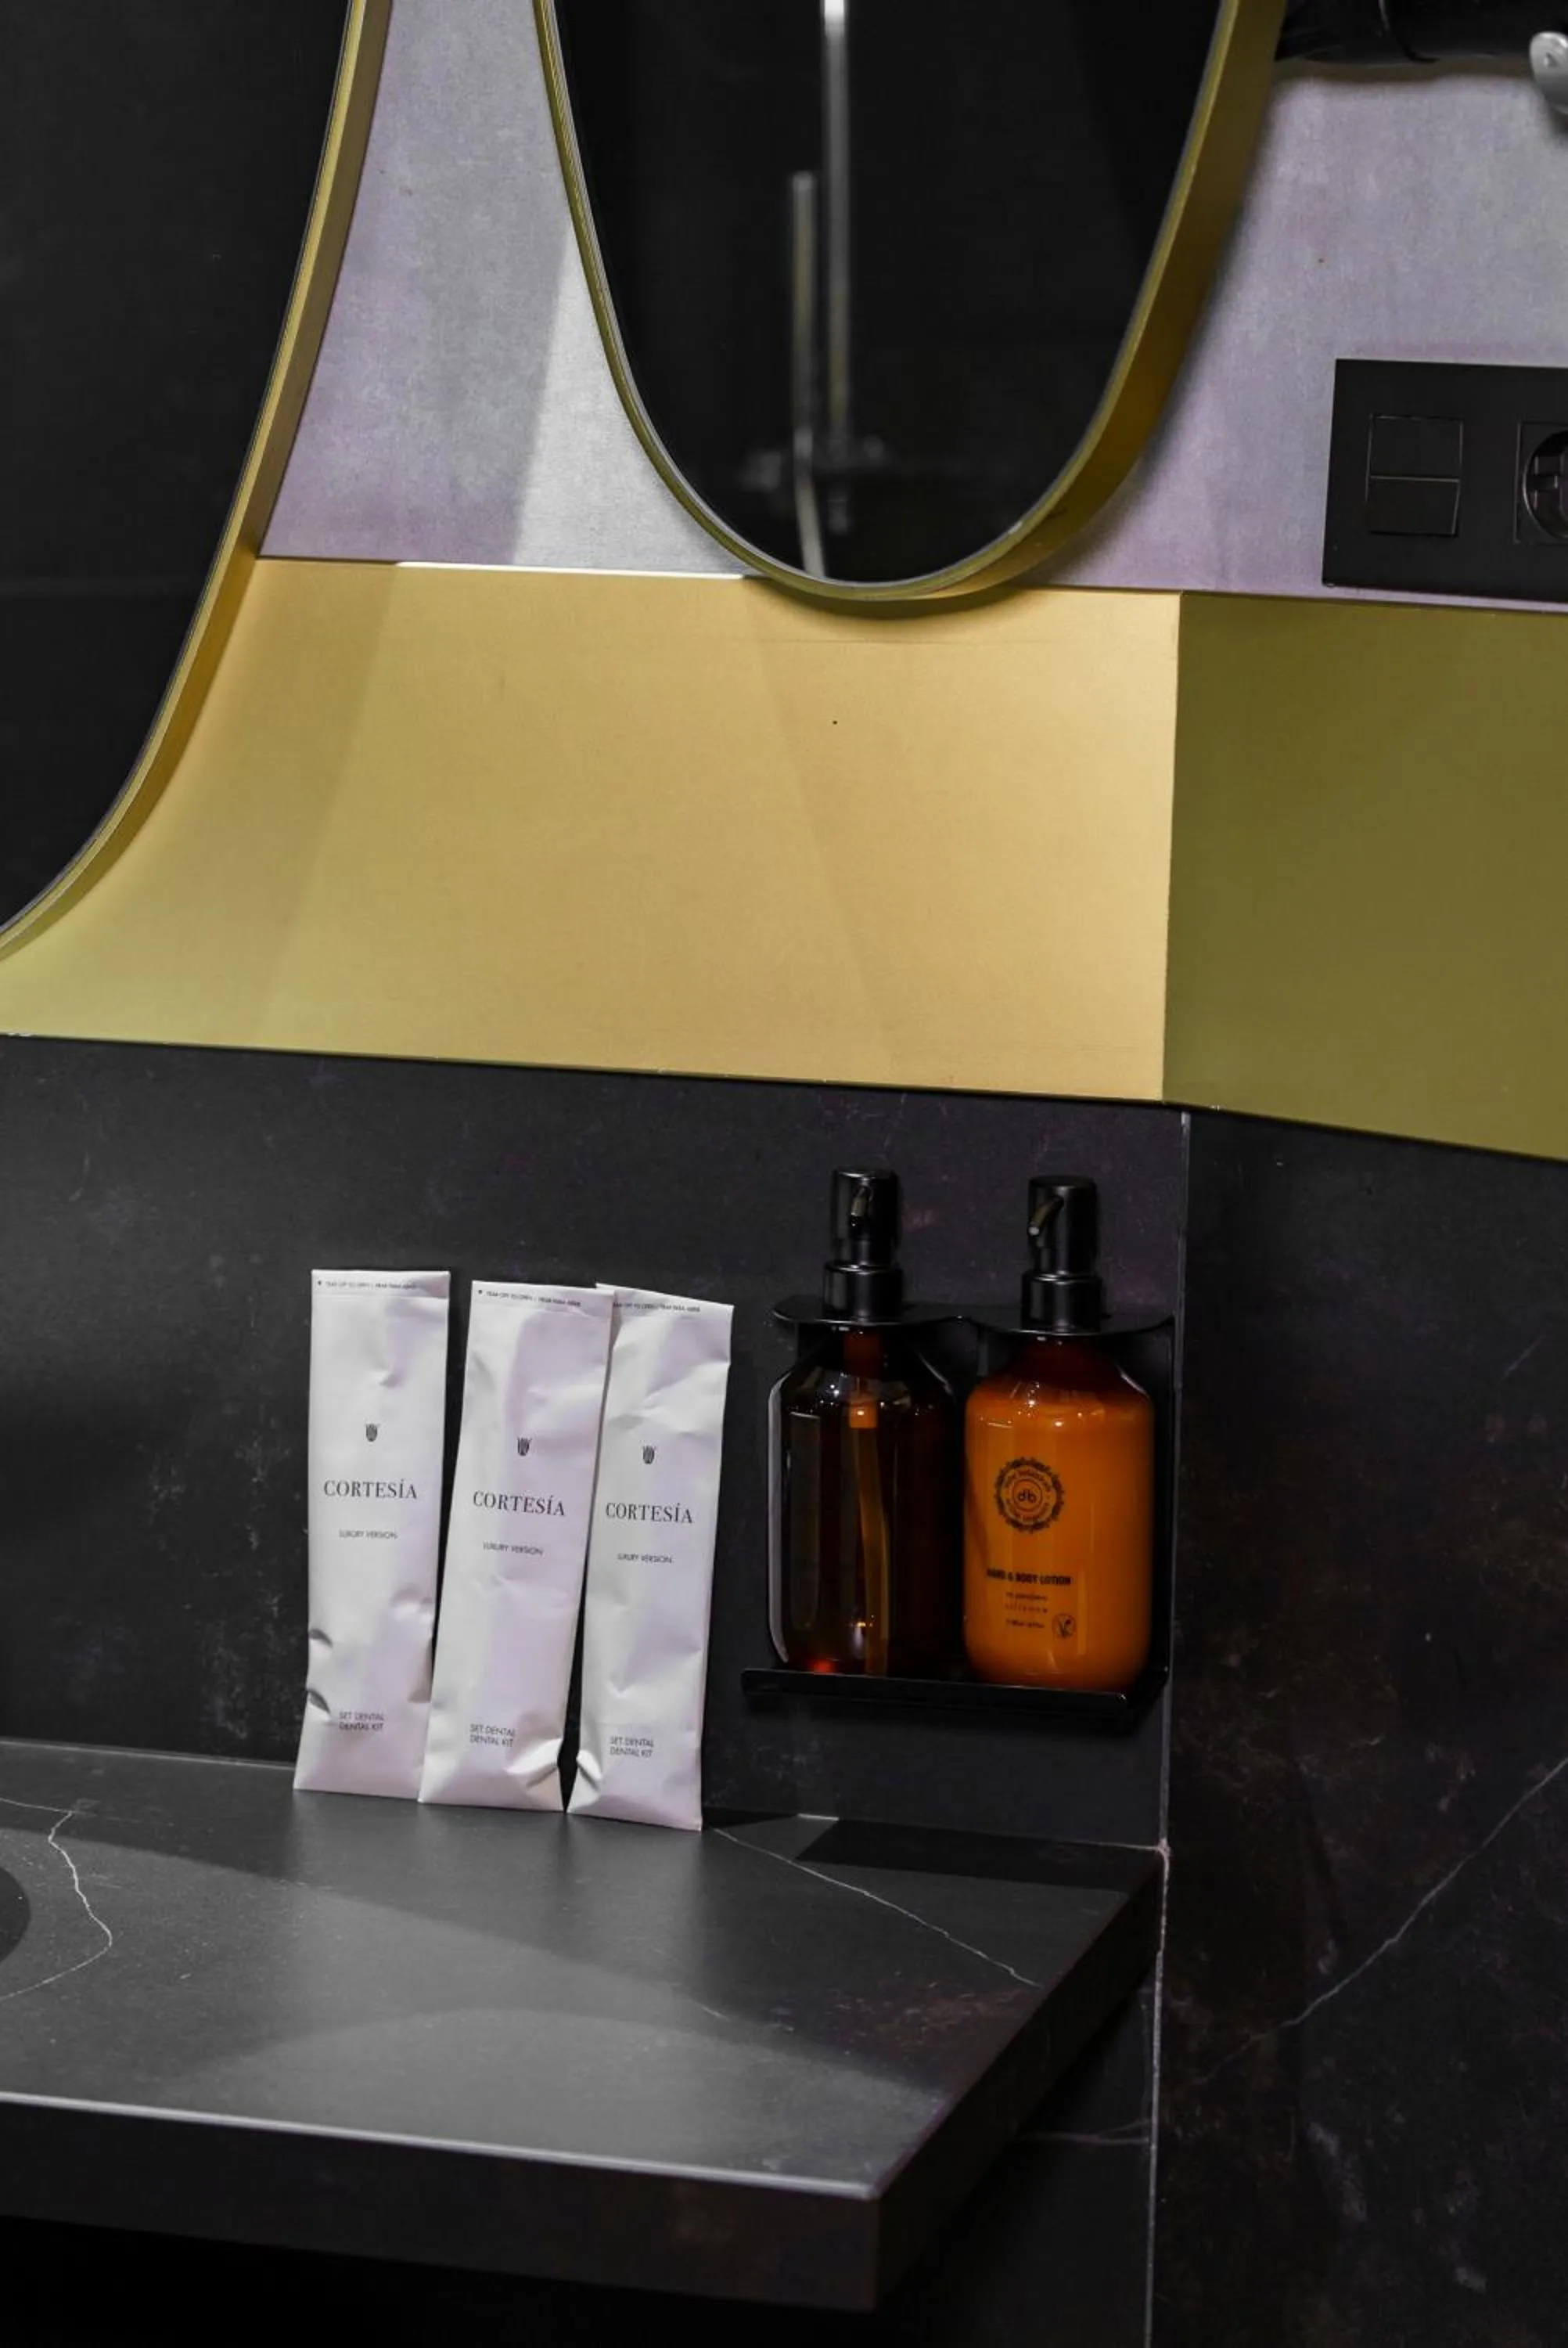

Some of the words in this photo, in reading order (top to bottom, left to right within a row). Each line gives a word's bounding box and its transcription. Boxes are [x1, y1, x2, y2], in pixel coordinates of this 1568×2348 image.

[323, 1478, 417, 1500] CORTESÍA
[473, 1490, 565, 1517] CORTESÍA
[606, 1502, 692, 1523] CORTESÍA
[469, 1734, 498, 1745] DENTAL
[502, 1738, 513, 1748] KIT
[486, 1725, 516, 1737] DENTAL
